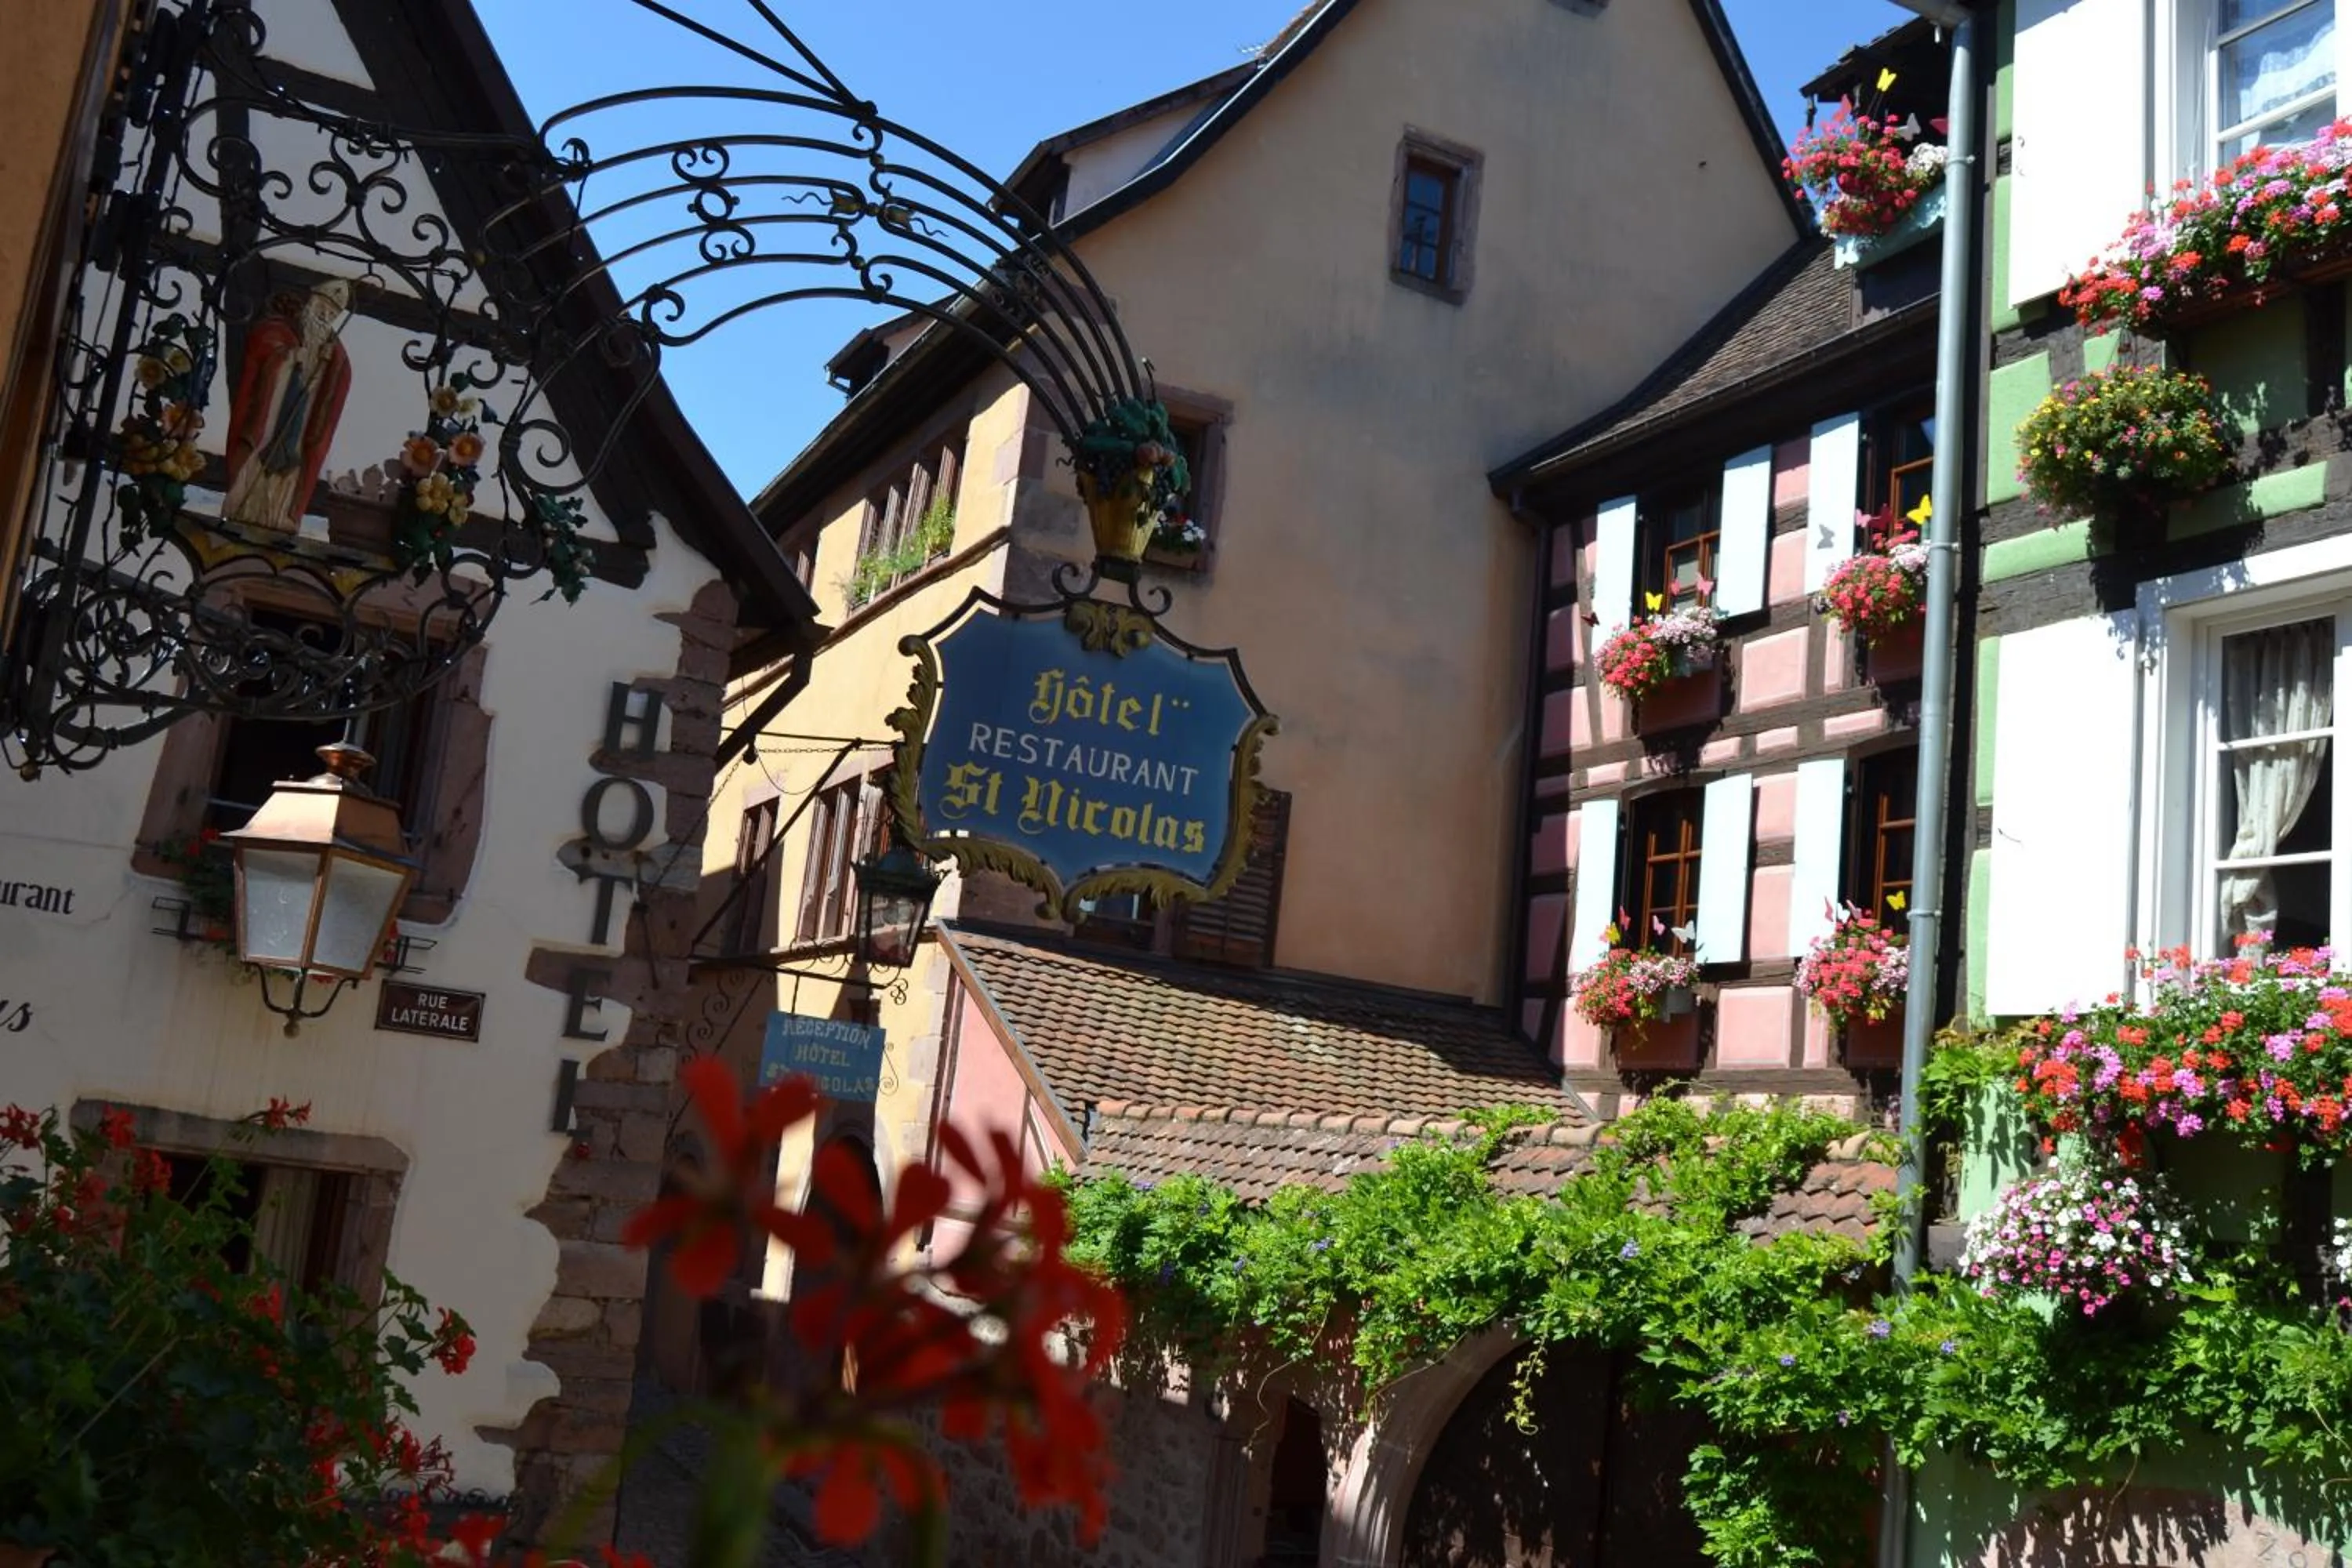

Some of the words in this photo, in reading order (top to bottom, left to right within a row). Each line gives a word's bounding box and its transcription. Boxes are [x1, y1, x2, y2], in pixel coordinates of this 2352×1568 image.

[1029, 669, 1163, 736] Hôtel
[968, 722, 1199, 795] RESTAURANT
[939, 761, 1004, 819] St
[1019, 775, 1206, 854] Nicolas
[551, 681, 665, 1138] HOTEL
[391, 1006, 470, 1032] LATERALE
[417, 993, 449, 1009] RUE
